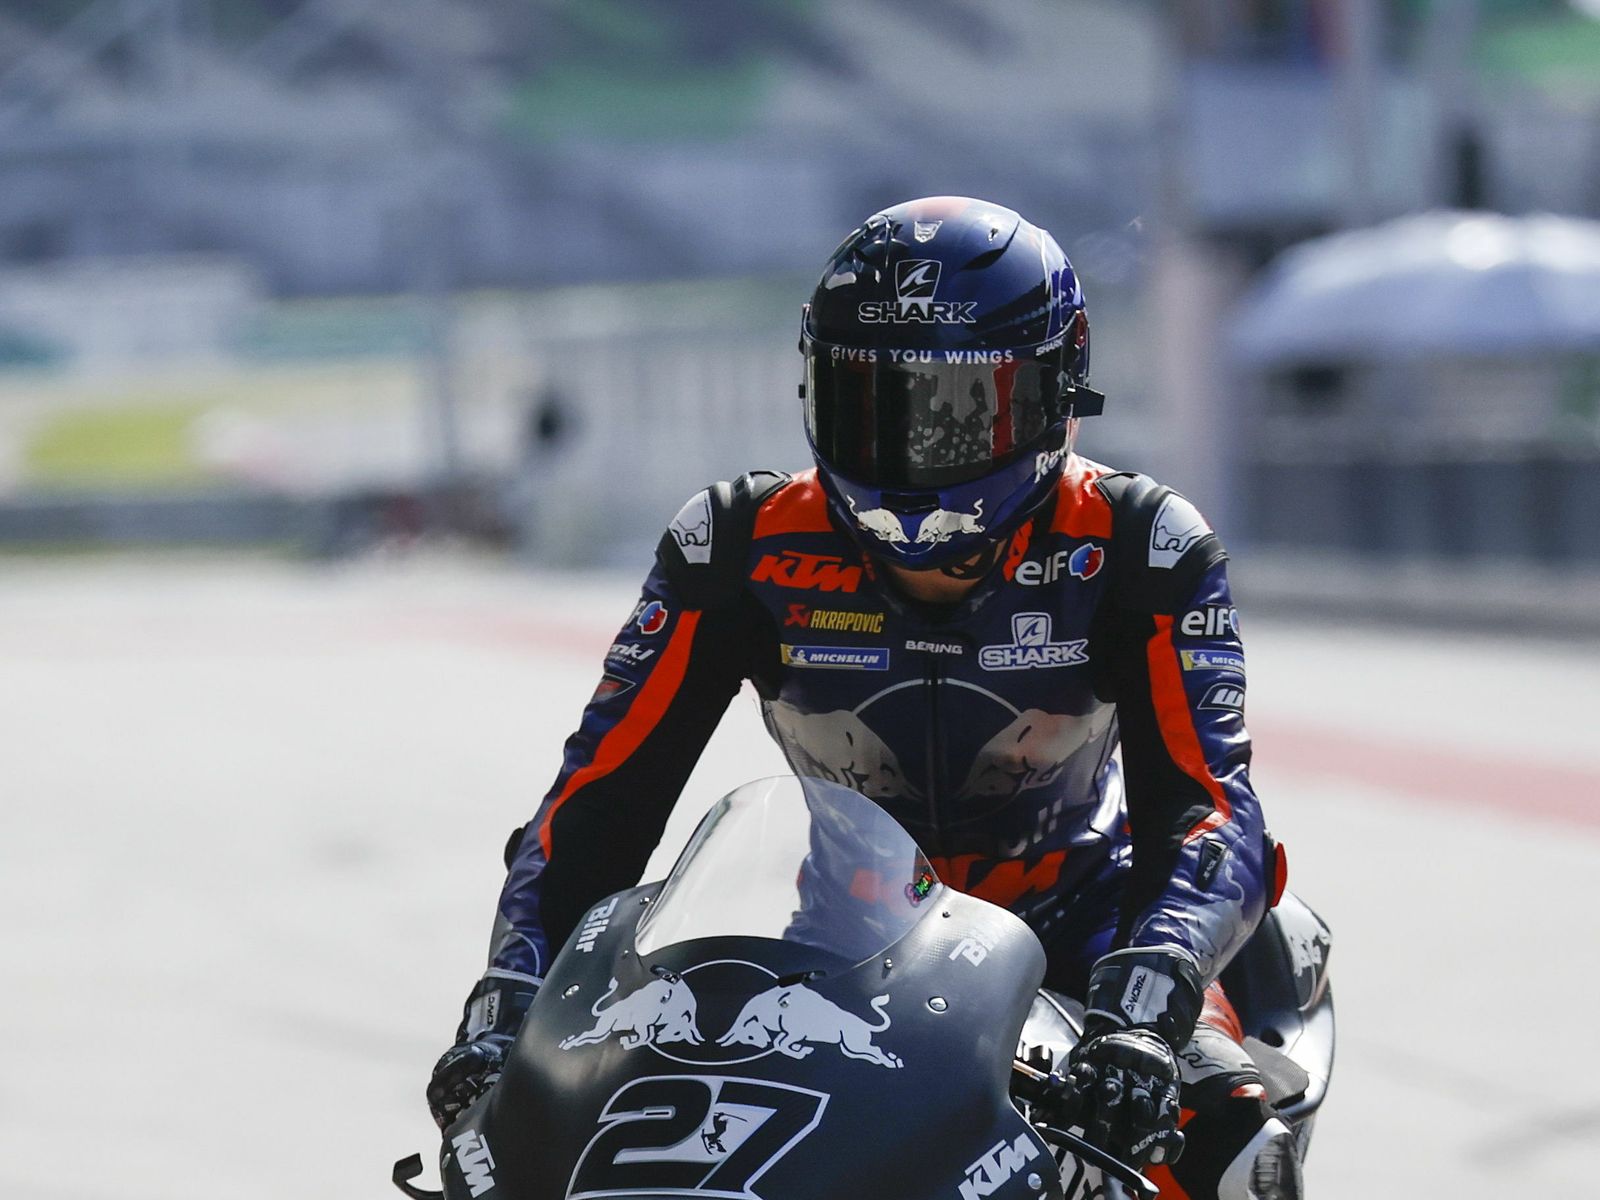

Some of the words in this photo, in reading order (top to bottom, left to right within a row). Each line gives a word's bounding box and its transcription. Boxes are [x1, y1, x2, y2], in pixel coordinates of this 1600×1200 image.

[858, 302, 977, 323] SHARK
[831, 346, 877, 363] GIVES
[889, 350, 933, 364] YOU
[945, 350, 1013, 364] WINGS
[751, 551, 863, 593] KTM
[1015, 552, 1067, 585] elf
[1181, 608, 1230, 635] elf
[809, 653, 879, 663] MICHELIN
[905, 639, 963, 655] BERING
[979, 639, 1089, 670] SHARK
[451, 1129, 496, 1198] KTM
